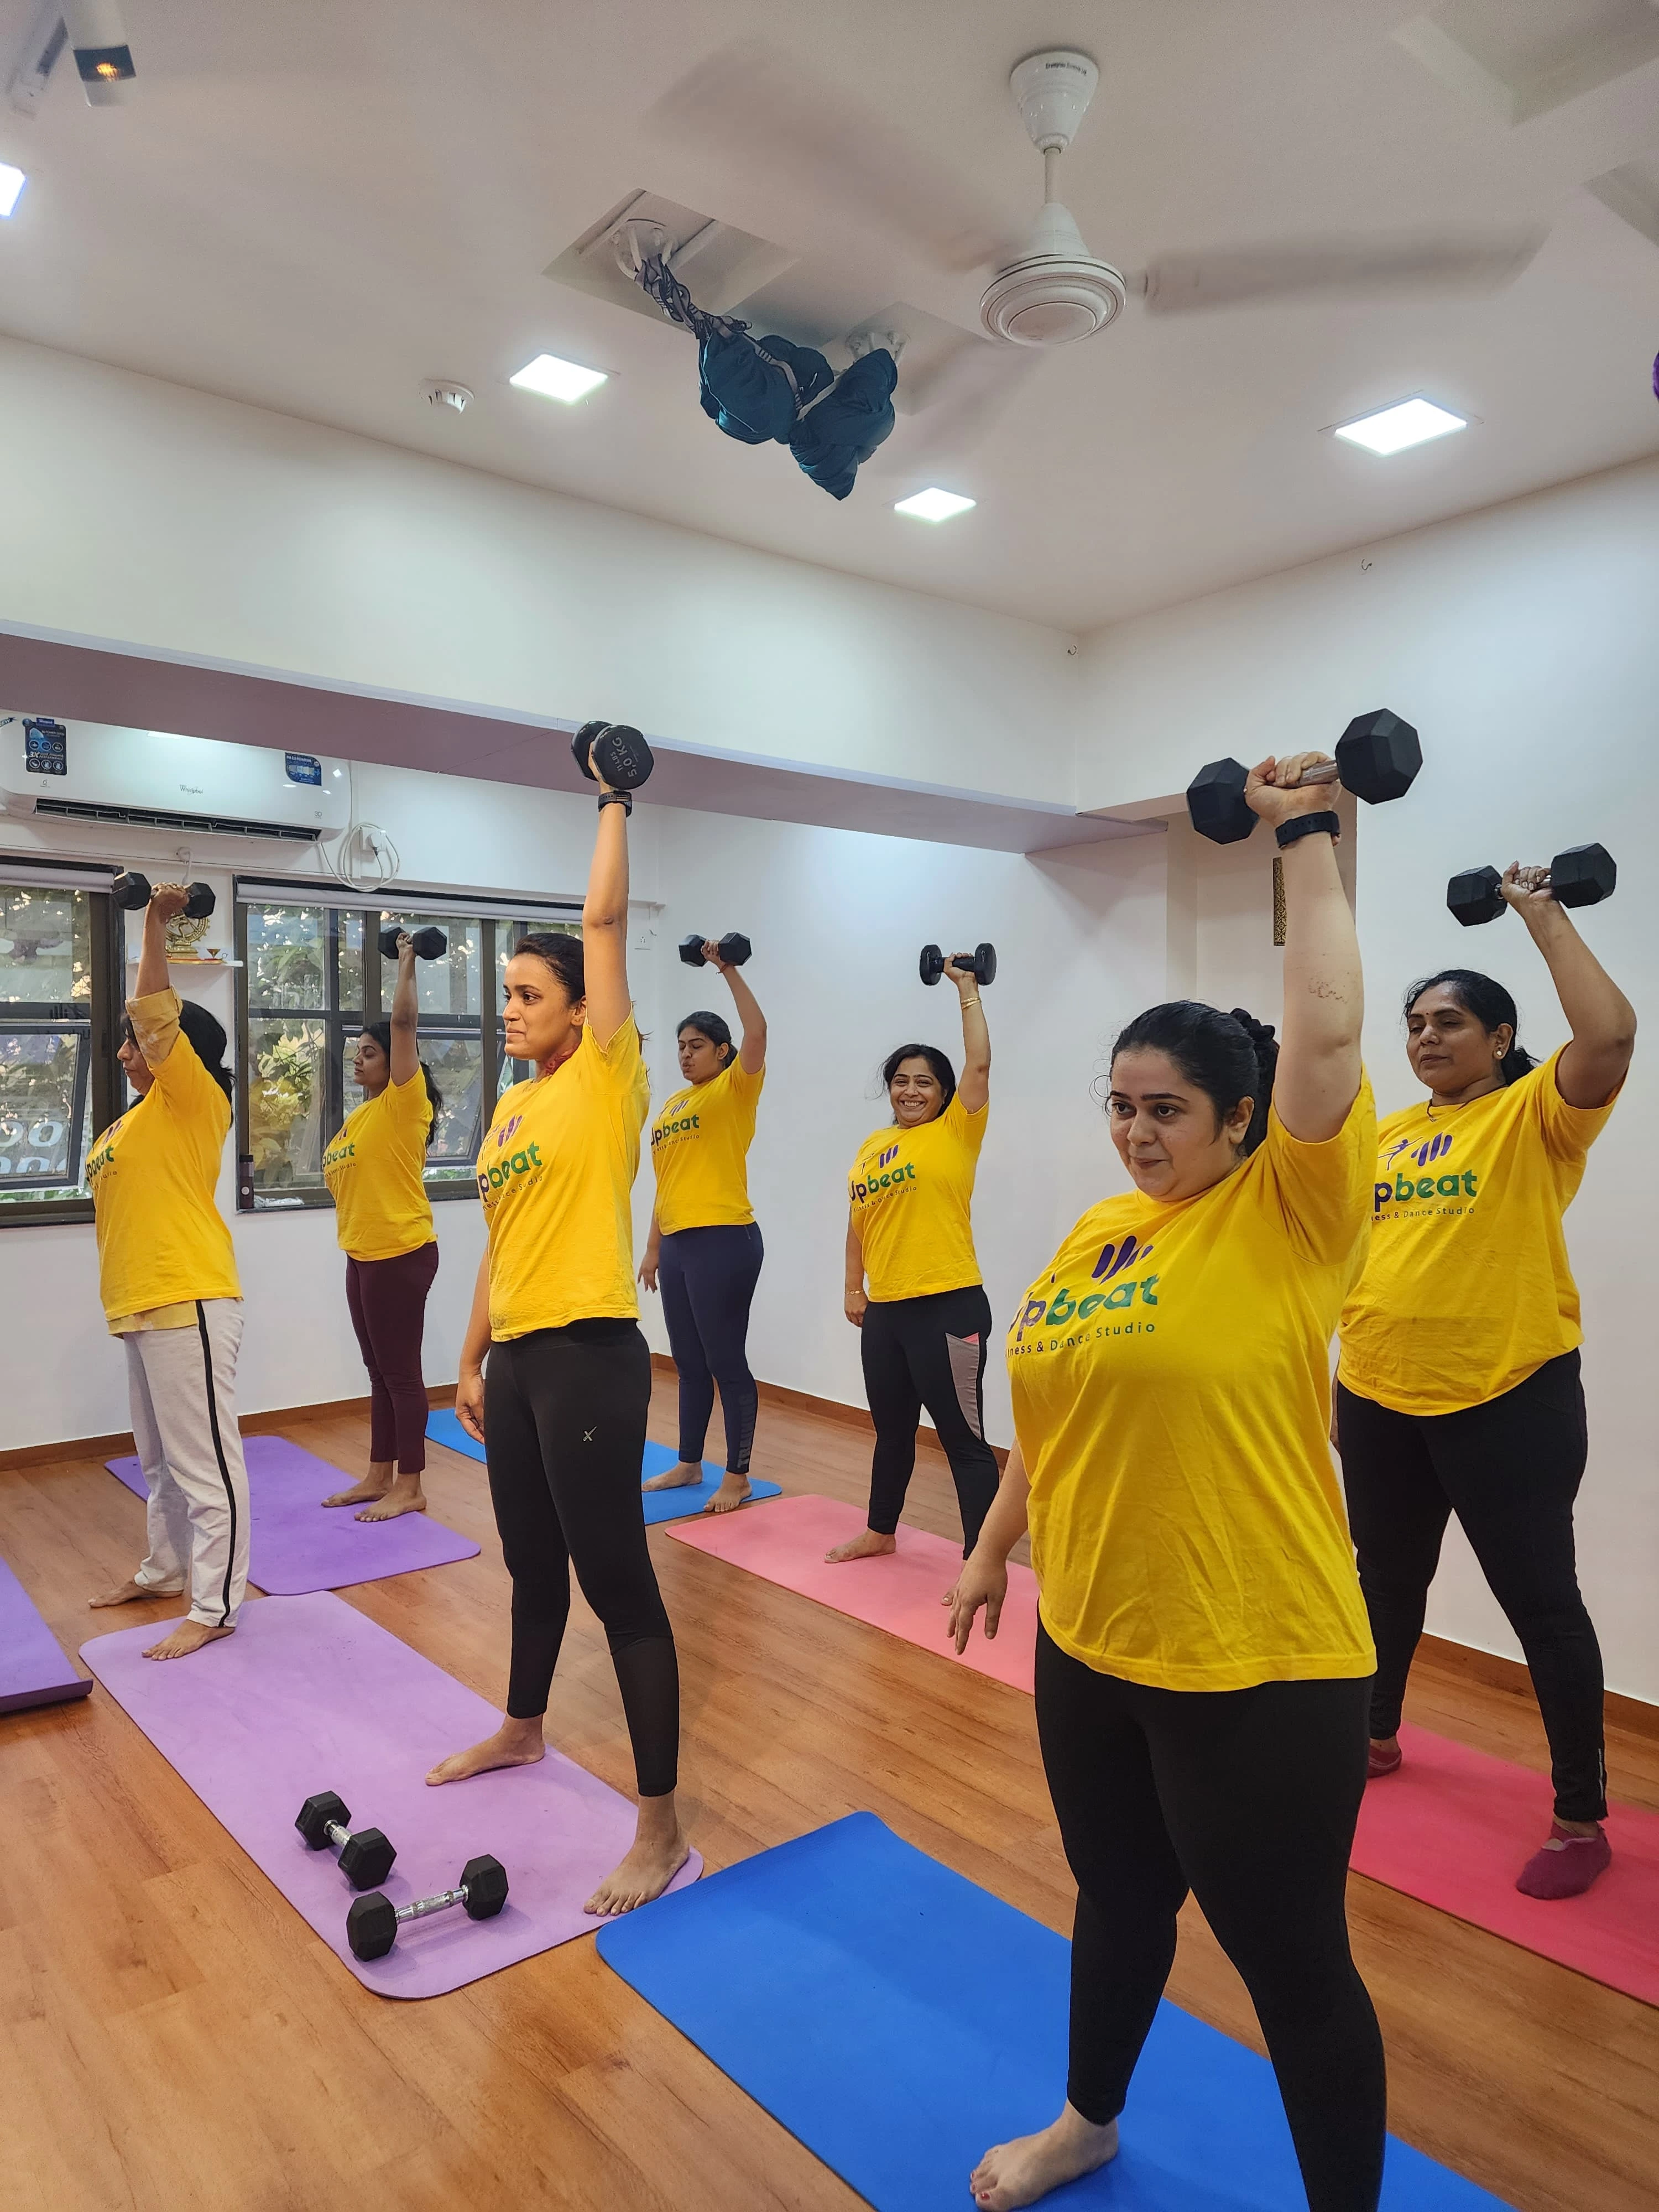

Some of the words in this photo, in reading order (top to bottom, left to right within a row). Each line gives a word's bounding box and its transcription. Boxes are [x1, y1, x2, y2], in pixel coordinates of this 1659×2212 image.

[612, 737, 628, 756] KG
[179, 784, 203, 794] Whirlpool
[478, 1141, 542, 1203] pbeat
[1374, 1169, 1477, 1212] pbeat
[1403, 1209, 1433, 1218] Dance
[1436, 1207, 1475, 1215] Studio
[1036, 1340, 1044, 1352] &
[1095, 1321, 1155, 1338] Studio
